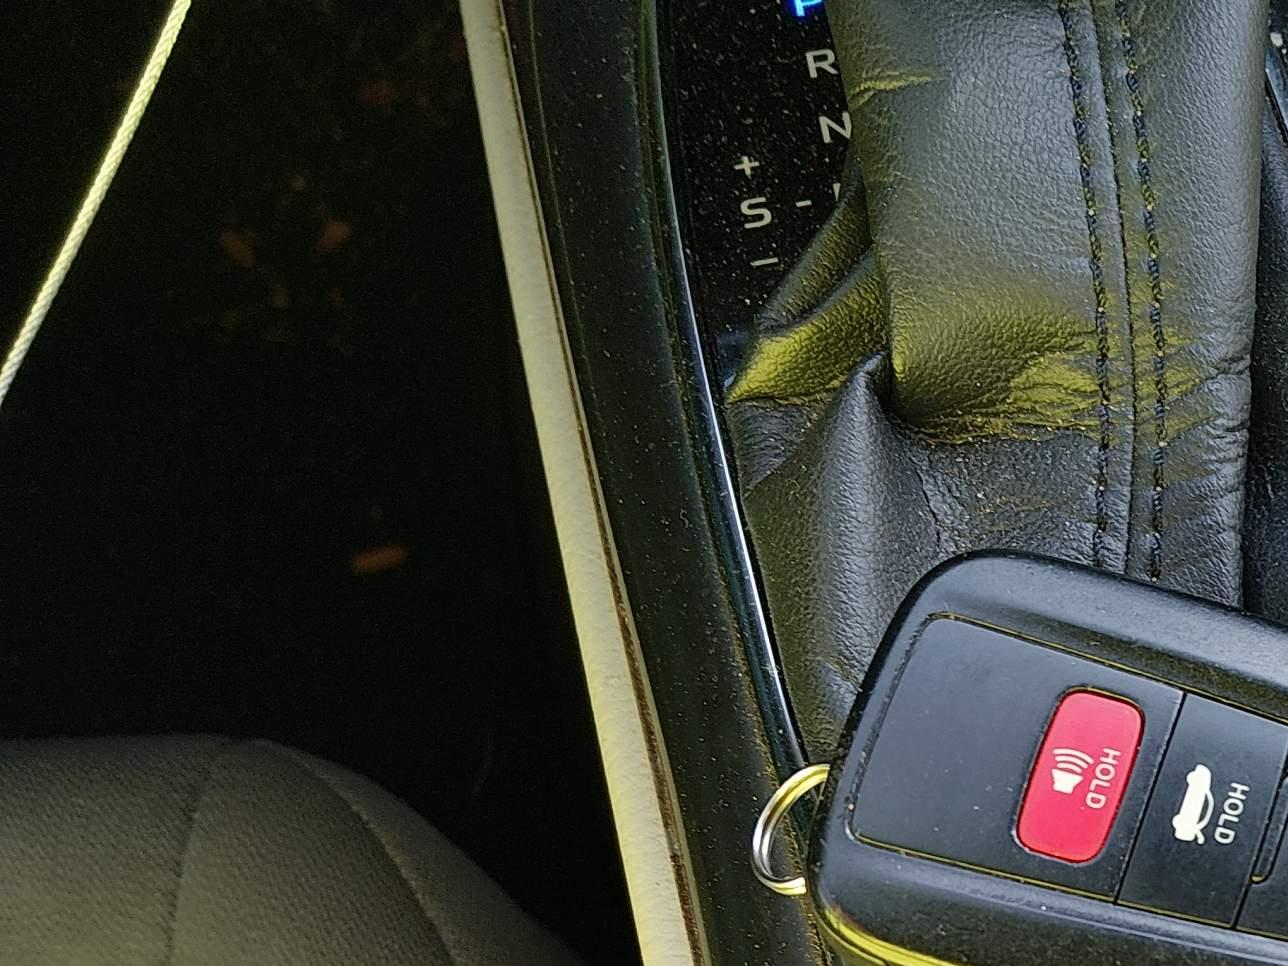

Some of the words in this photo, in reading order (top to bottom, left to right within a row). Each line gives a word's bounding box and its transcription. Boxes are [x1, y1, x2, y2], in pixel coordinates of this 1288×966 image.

[805, 49, 838, 79] R
[818, 111, 852, 143] N
[740, 197, 772, 229] S
[1086, 748, 1121, 809] HOLD
[1214, 782, 1250, 845] HOLD
